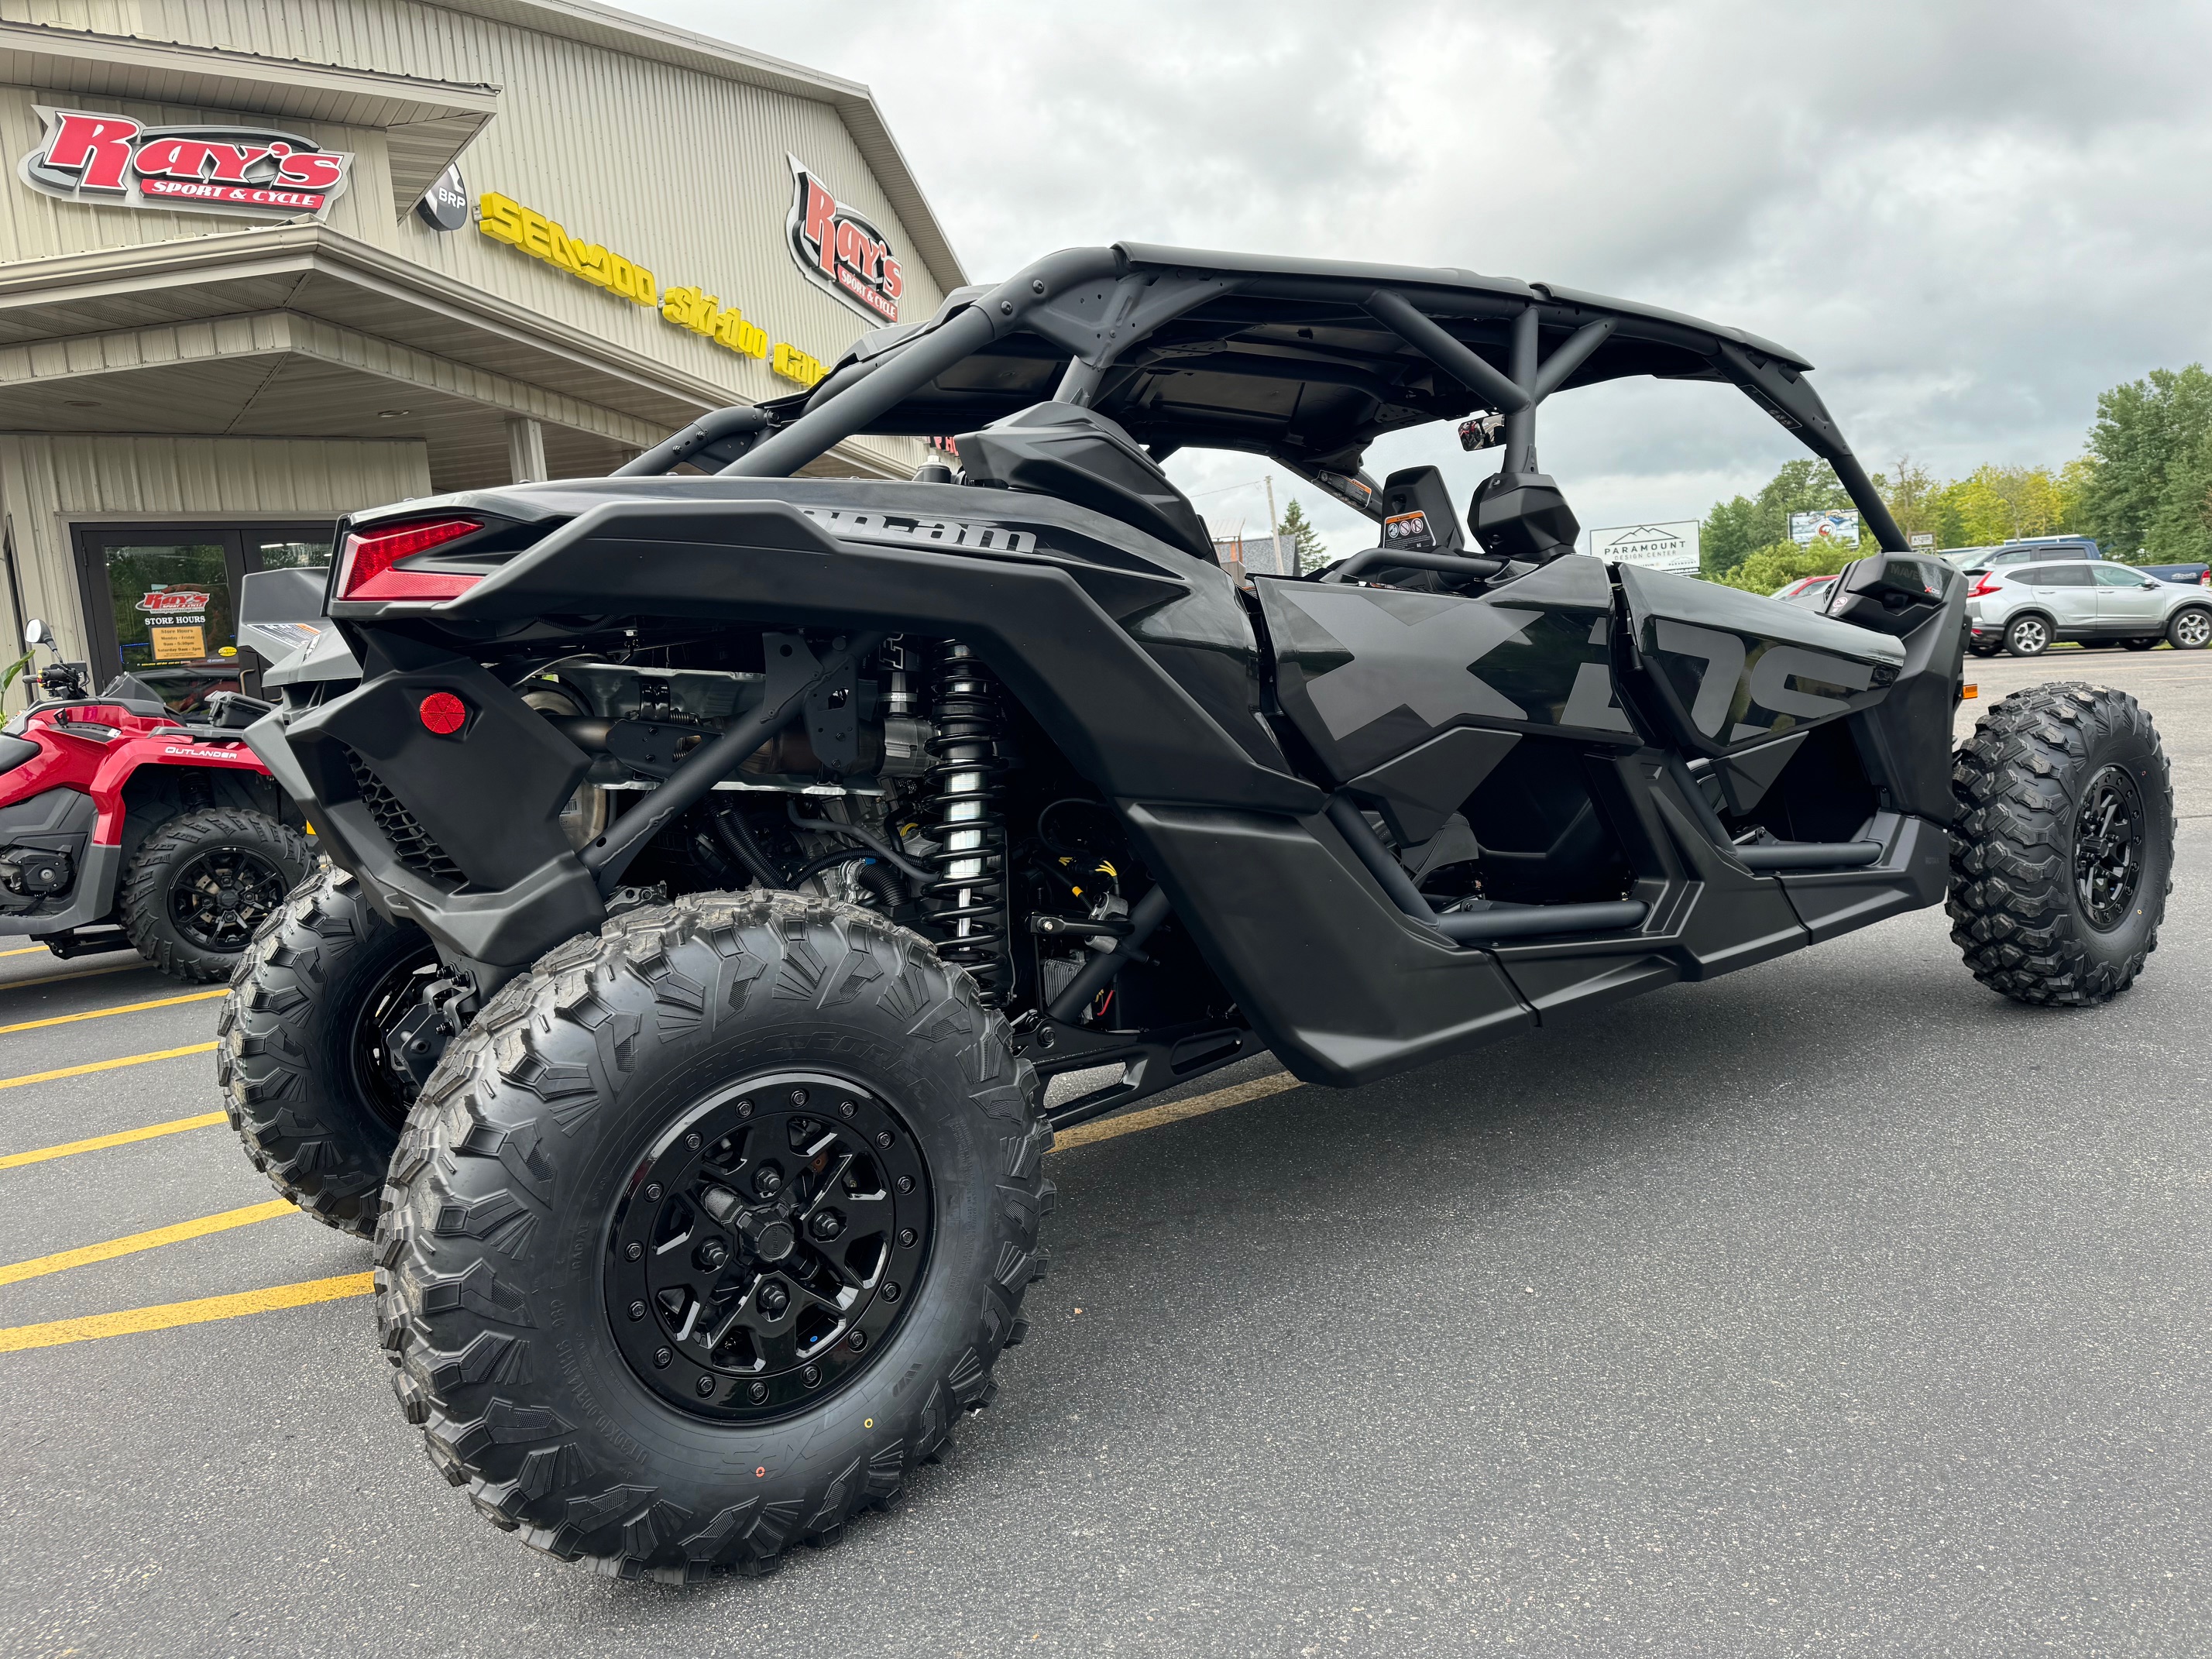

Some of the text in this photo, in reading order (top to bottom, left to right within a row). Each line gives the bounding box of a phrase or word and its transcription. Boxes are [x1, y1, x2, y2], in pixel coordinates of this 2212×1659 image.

[152, 181, 323, 207] SPORT & CYCLE
[438, 187, 465, 209] BRP
[841, 270, 896, 318] SPORT & CYCLE
[1604, 541, 1686, 555] PARAMOUNT
[144, 616, 206, 625] STORE HOURS
